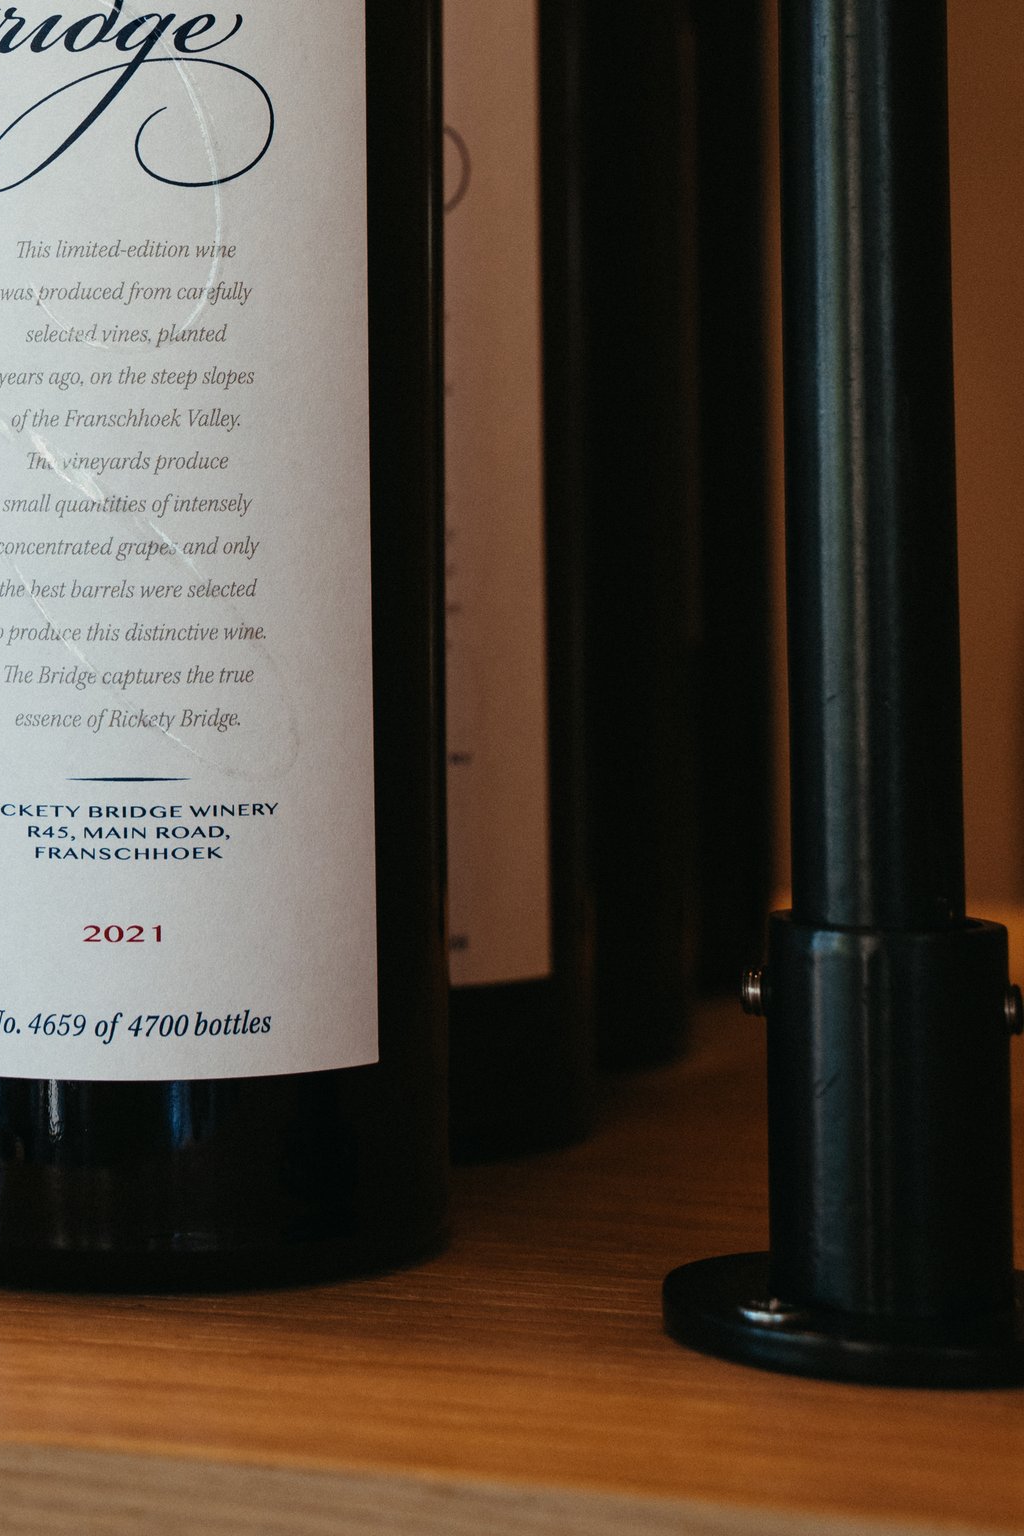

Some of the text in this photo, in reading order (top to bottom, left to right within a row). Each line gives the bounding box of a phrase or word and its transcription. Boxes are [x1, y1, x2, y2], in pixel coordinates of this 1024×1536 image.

[17, 239, 237, 259] This limited-edition wine
[0, 282, 253, 306] was produced from carefully
[26, 324, 227, 347] selected vines, planted
[48, 370, 84, 391] ago,
[90, 370, 112, 385] on
[118, 366, 146, 385] the
[151, 369, 197, 390] steep
[202, 366, 255, 390] slopes
[11, 409, 241, 432] of the Franschhoek Valley.
[62, 452, 150, 475] vineyards
[154, 452, 229, 475] produce
[2, 493, 253, 518] small quantities of intensely
[116, 540, 177, 561] grapes
[183, 537, 218, 555] and
[223, 536, 260, 560] only
[30, 580, 65, 598] best
[70, 580, 134, 598] barrels
[140, 583, 182, 598] were
[187, 578, 257, 598] selected
[7, 623, 81, 645] produce
[87, 623, 119, 641] this
[125, 623, 218, 641] distinctive
[224, 623, 267, 641] wine.
[4, 665, 254, 690] The Bridge captures the true
[15, 709, 241, 733] essence of Rickety Bridge.
[88, 805, 182, 818] BRIDGE
[190, 802, 279, 818] WINERY
[27, 825, 231, 841] R45, MAIN ROAD,
[35, 846, 223, 860] FRANSCHHOEK
[83, 925, 162, 943] 2021
[28, 1013, 87, 1036] 4659
[95, 1013, 123, 1045] of
[127, 1013, 188, 1037] 4700
[194, 1010, 272, 1036] bottles
